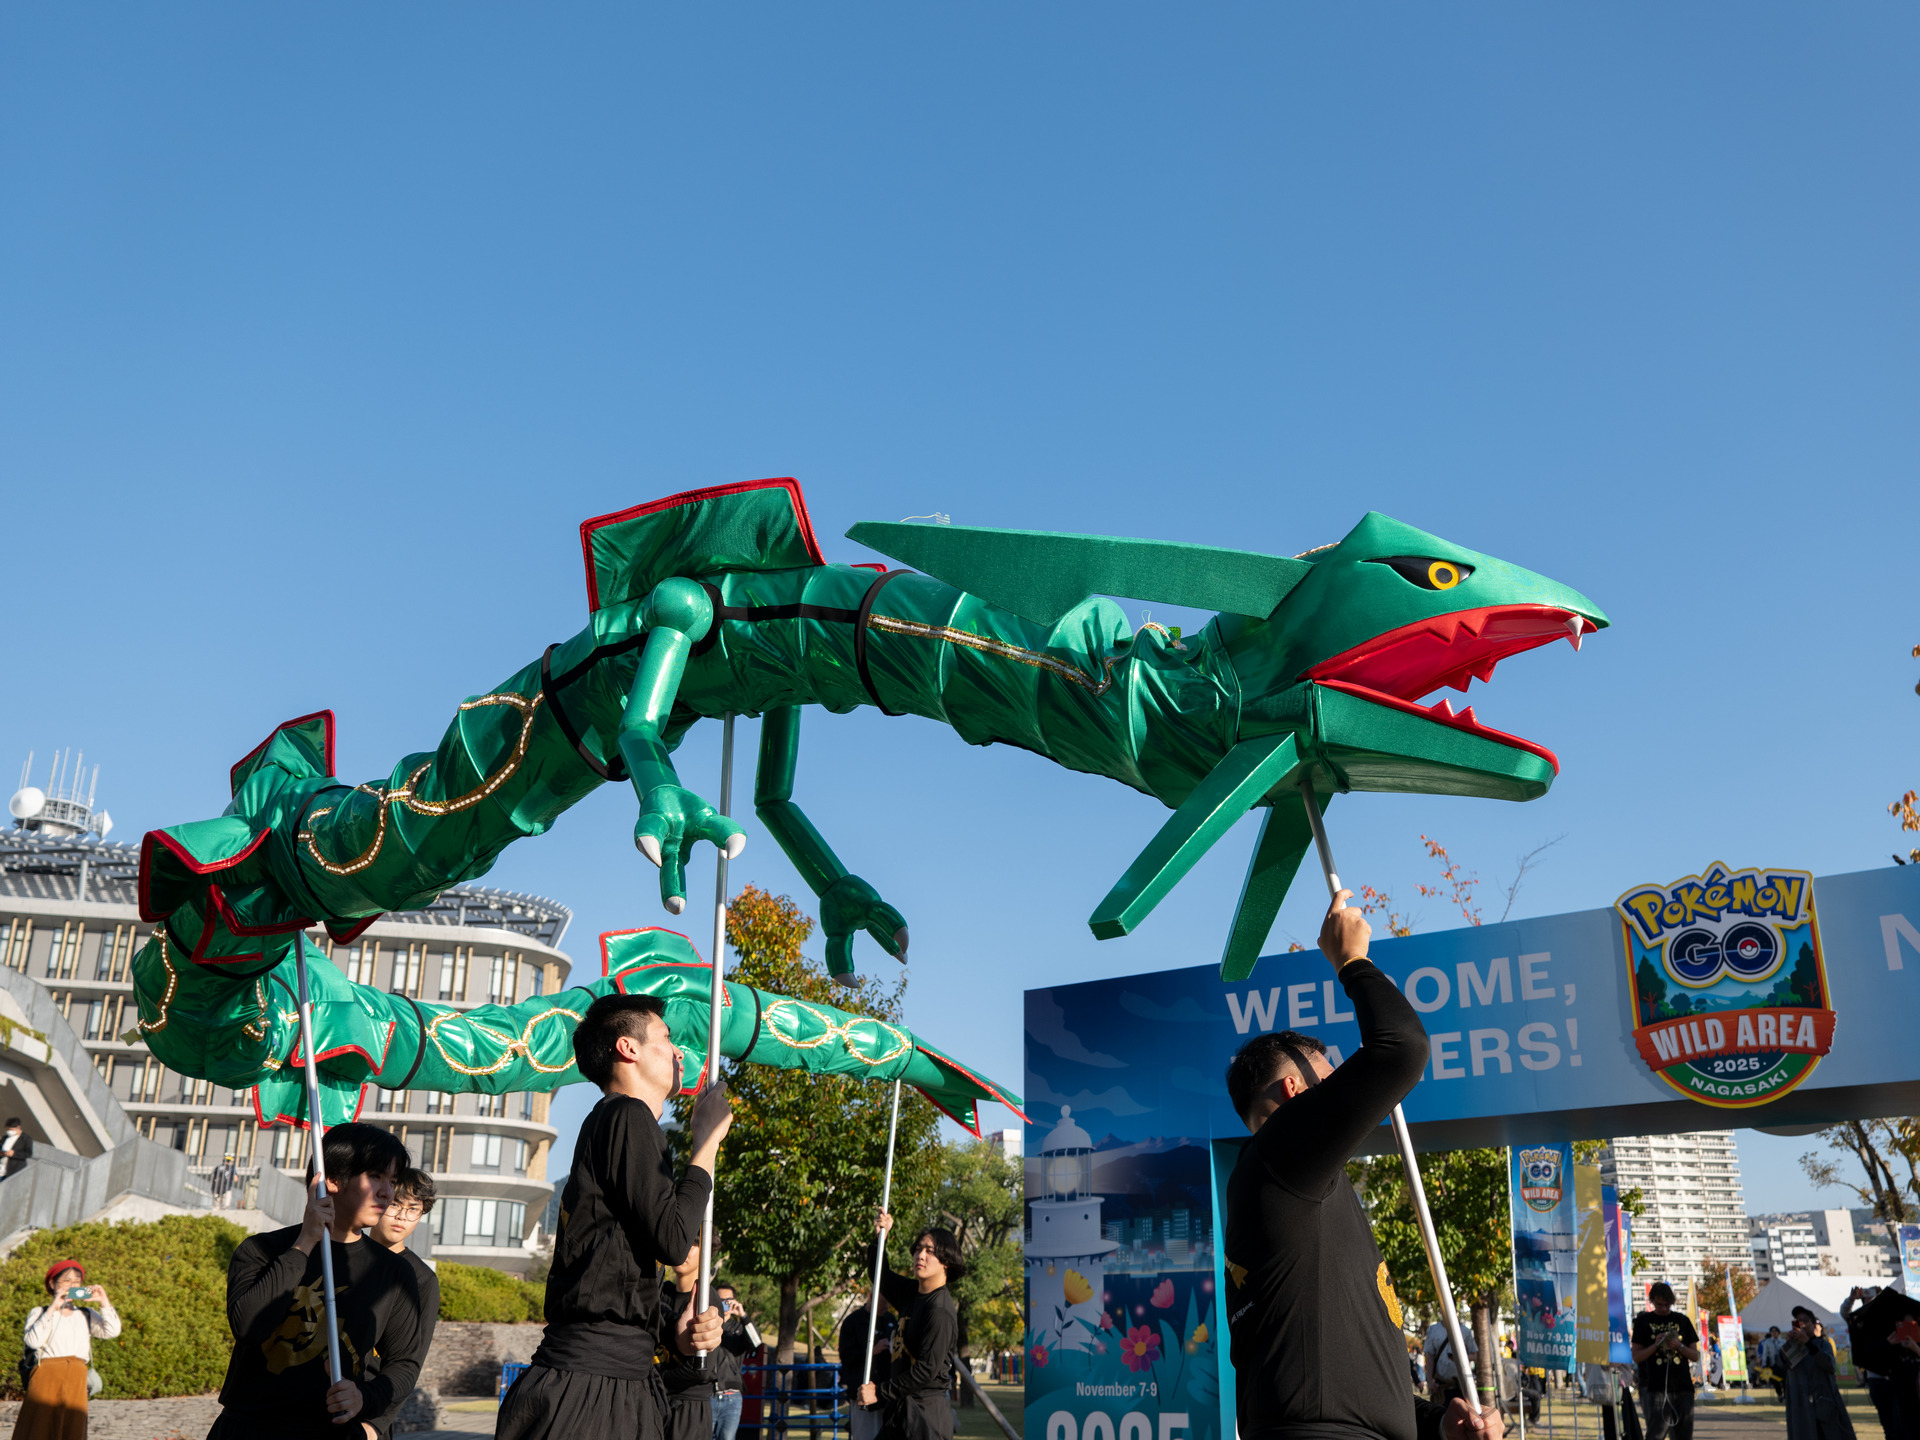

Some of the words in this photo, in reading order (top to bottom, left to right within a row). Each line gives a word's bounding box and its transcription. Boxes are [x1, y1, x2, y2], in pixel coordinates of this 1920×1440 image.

[1669, 921, 1778, 981] GO
[1225, 952, 1577, 1034] WELOME,
[1650, 1018, 1725, 1061] WILD
[1737, 1014, 1816, 1049] AREA
[1714, 1058, 1760, 1073] 2025
[1690, 1069, 1788, 1096] NAGASAKI
[1530, 1164, 1552, 1180] GO
[1523, 1189, 1540, 1199] WILD
[1542, 1188, 1559, 1200] AREA
[1527, 1330, 1544, 1340] Nov
[1076, 1382, 1136, 1397] November
[1139, 1382, 1158, 1397] 7-9
